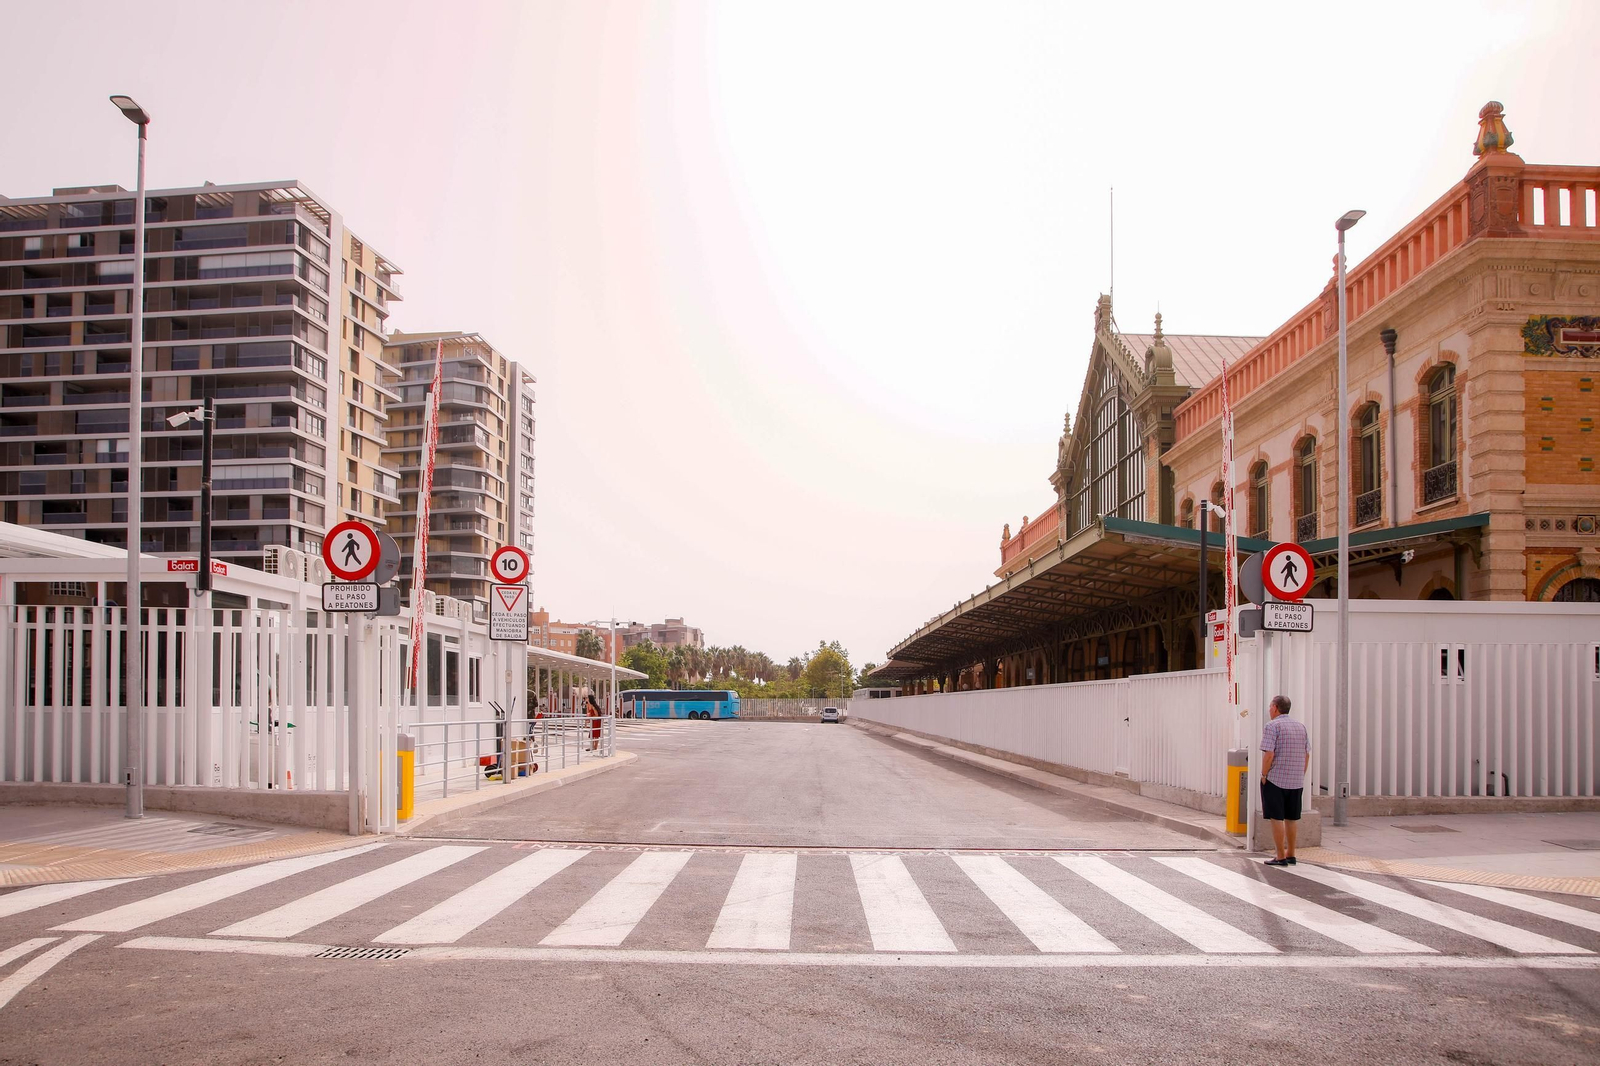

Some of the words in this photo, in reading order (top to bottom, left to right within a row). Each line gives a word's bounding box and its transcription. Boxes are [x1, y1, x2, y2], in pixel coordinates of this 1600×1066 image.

[172, 560, 194, 570] balat
[502, 559, 518, 571] 10
[1270, 604, 1307, 613] PROHIBIDO
[1274, 621, 1309, 629] PEATONES
